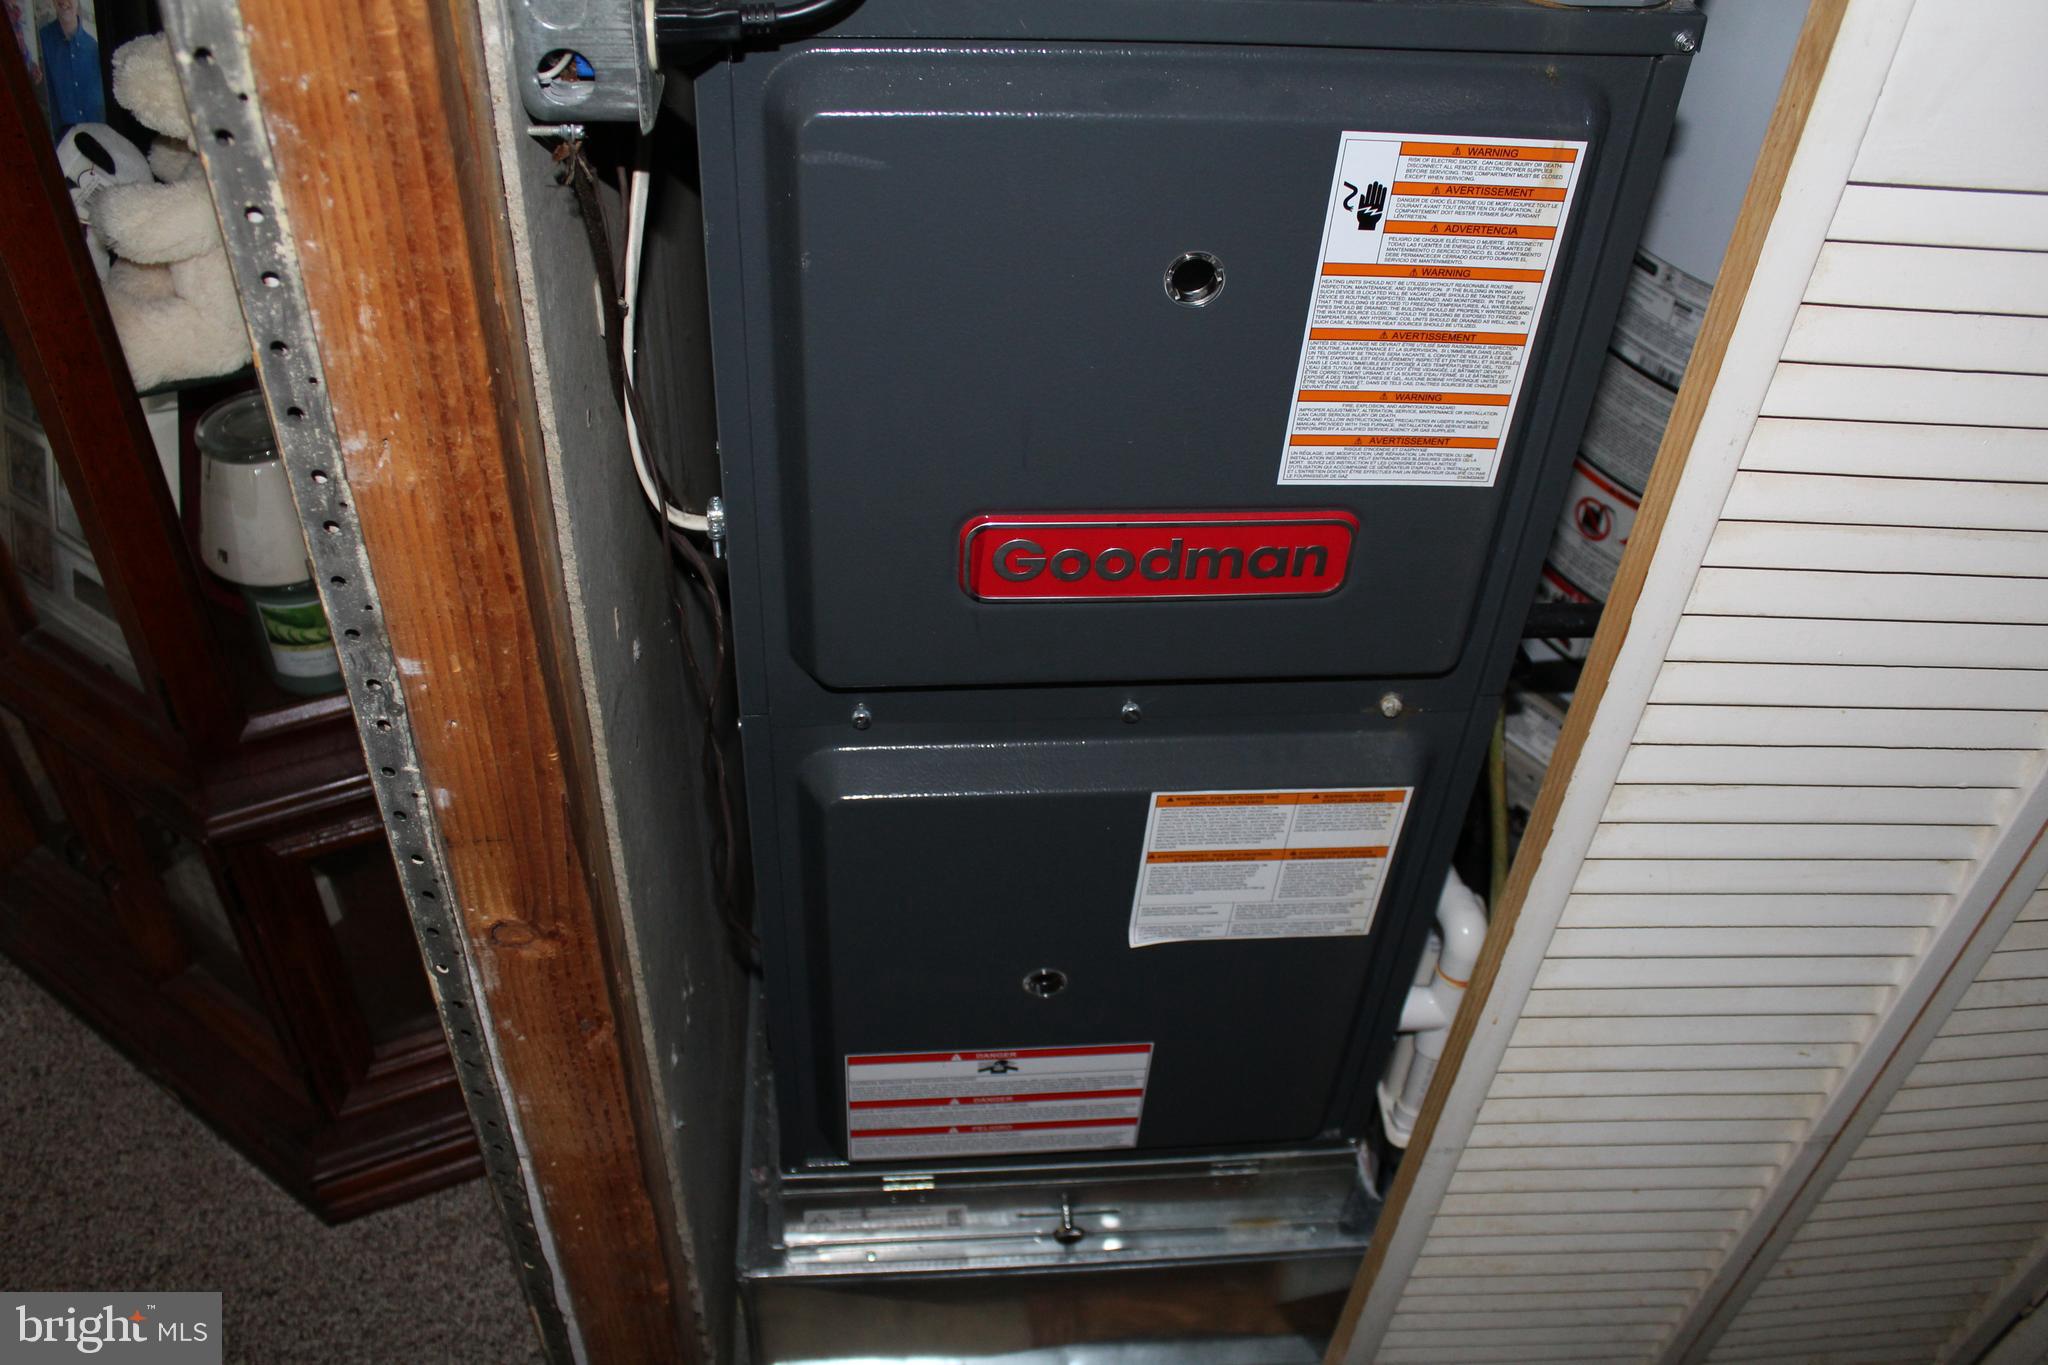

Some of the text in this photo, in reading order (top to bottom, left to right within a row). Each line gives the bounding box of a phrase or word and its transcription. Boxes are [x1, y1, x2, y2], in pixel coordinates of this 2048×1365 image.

[1466, 147, 1519, 157] WARNING
[1445, 185, 1534, 197] AVERTISSEMENT
[1443, 224, 1519, 235] ADVERTENCIA
[1420, 267, 1471, 277] WARNING
[1391, 332, 1476, 341] AVERTISSEMENT
[1394, 393, 1442, 401] WARNING
[1368, 437, 1450, 445] AVERTISSEMENT
[992, 537, 1329, 582] Goodman
[975, 1051, 1017, 1060] DANGER
